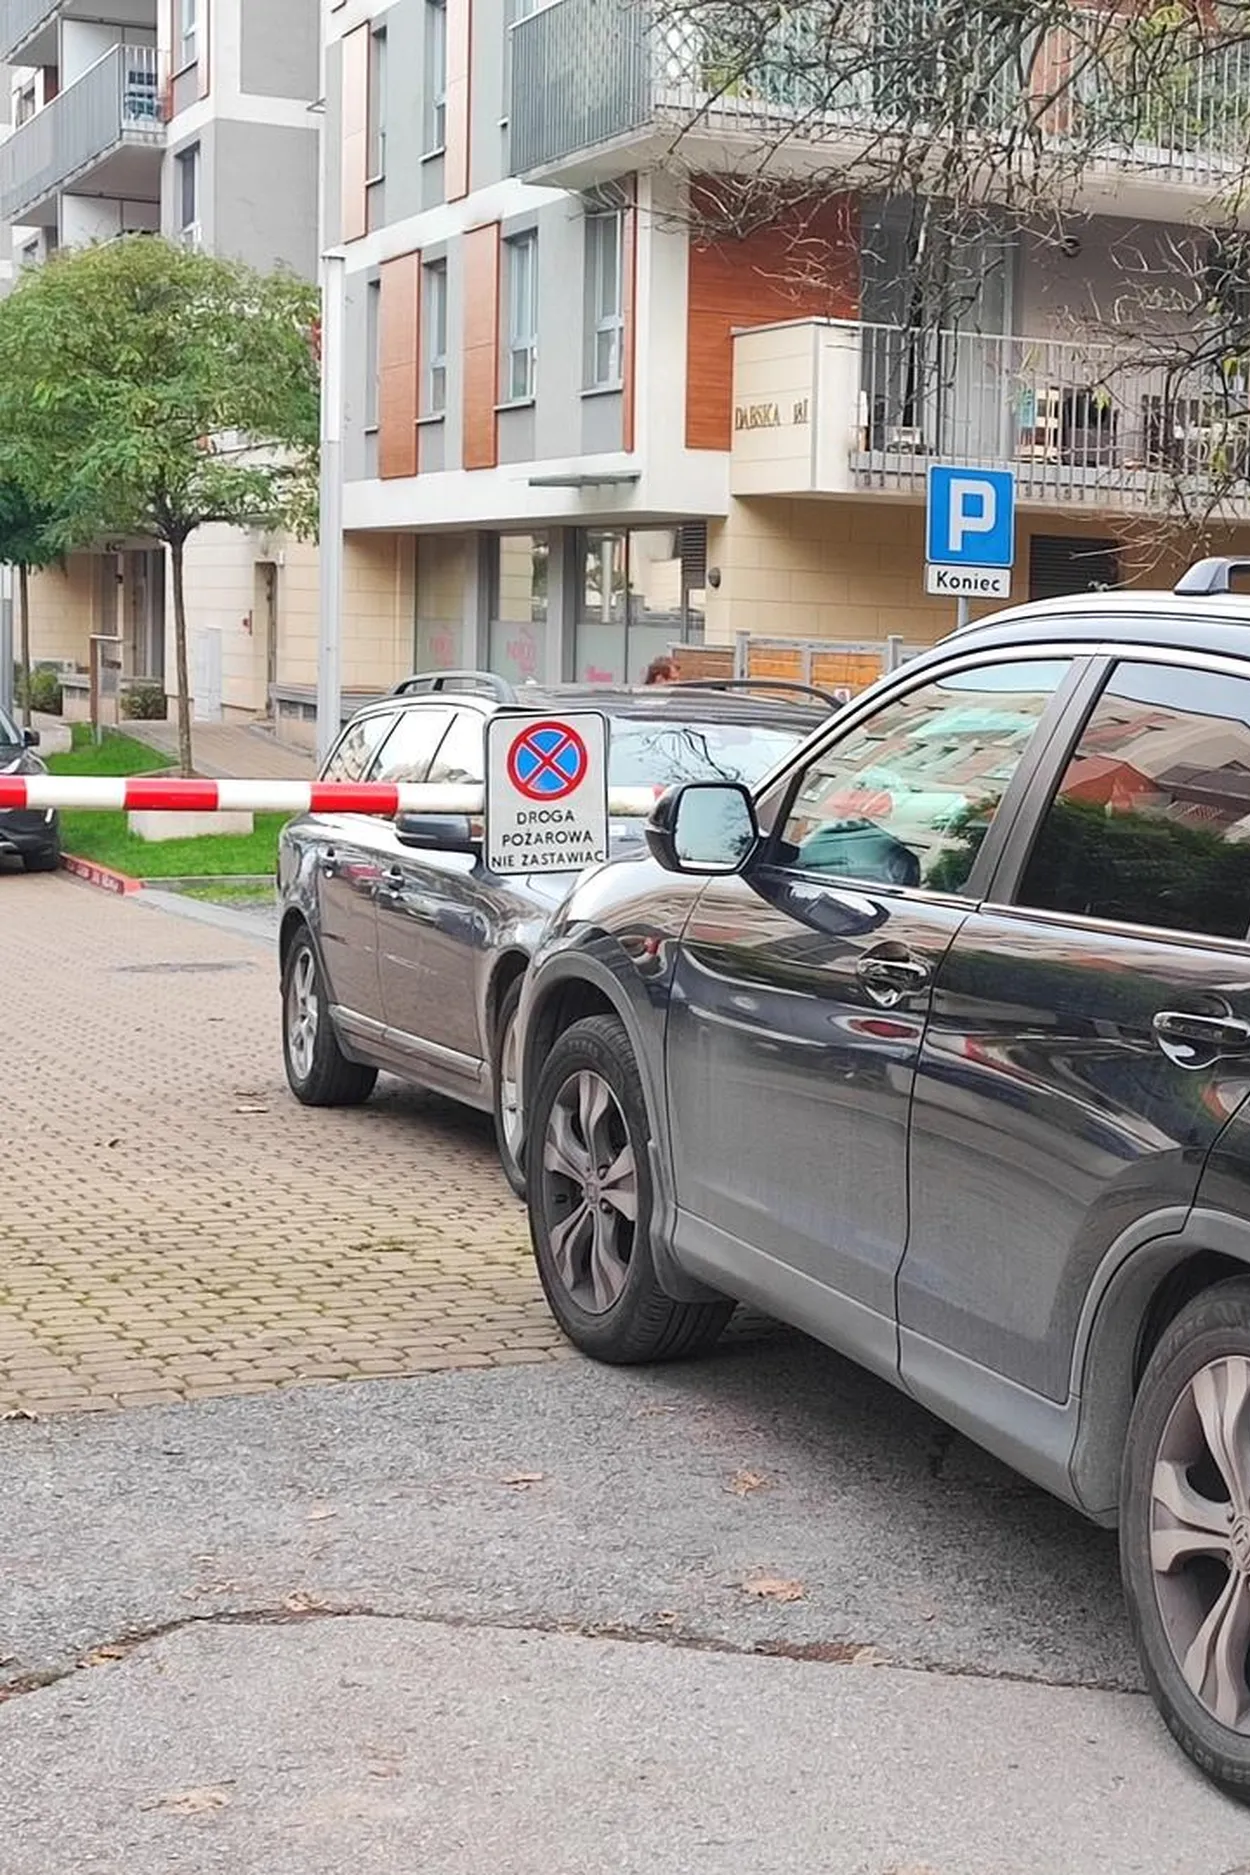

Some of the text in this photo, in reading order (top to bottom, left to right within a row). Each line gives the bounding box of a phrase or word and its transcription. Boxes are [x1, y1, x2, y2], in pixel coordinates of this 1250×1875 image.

[948, 479, 996, 551] P
[936, 570, 1001, 592] Koniec
[516, 809, 575, 825] DROGA
[491, 855, 515, 868] NIE
